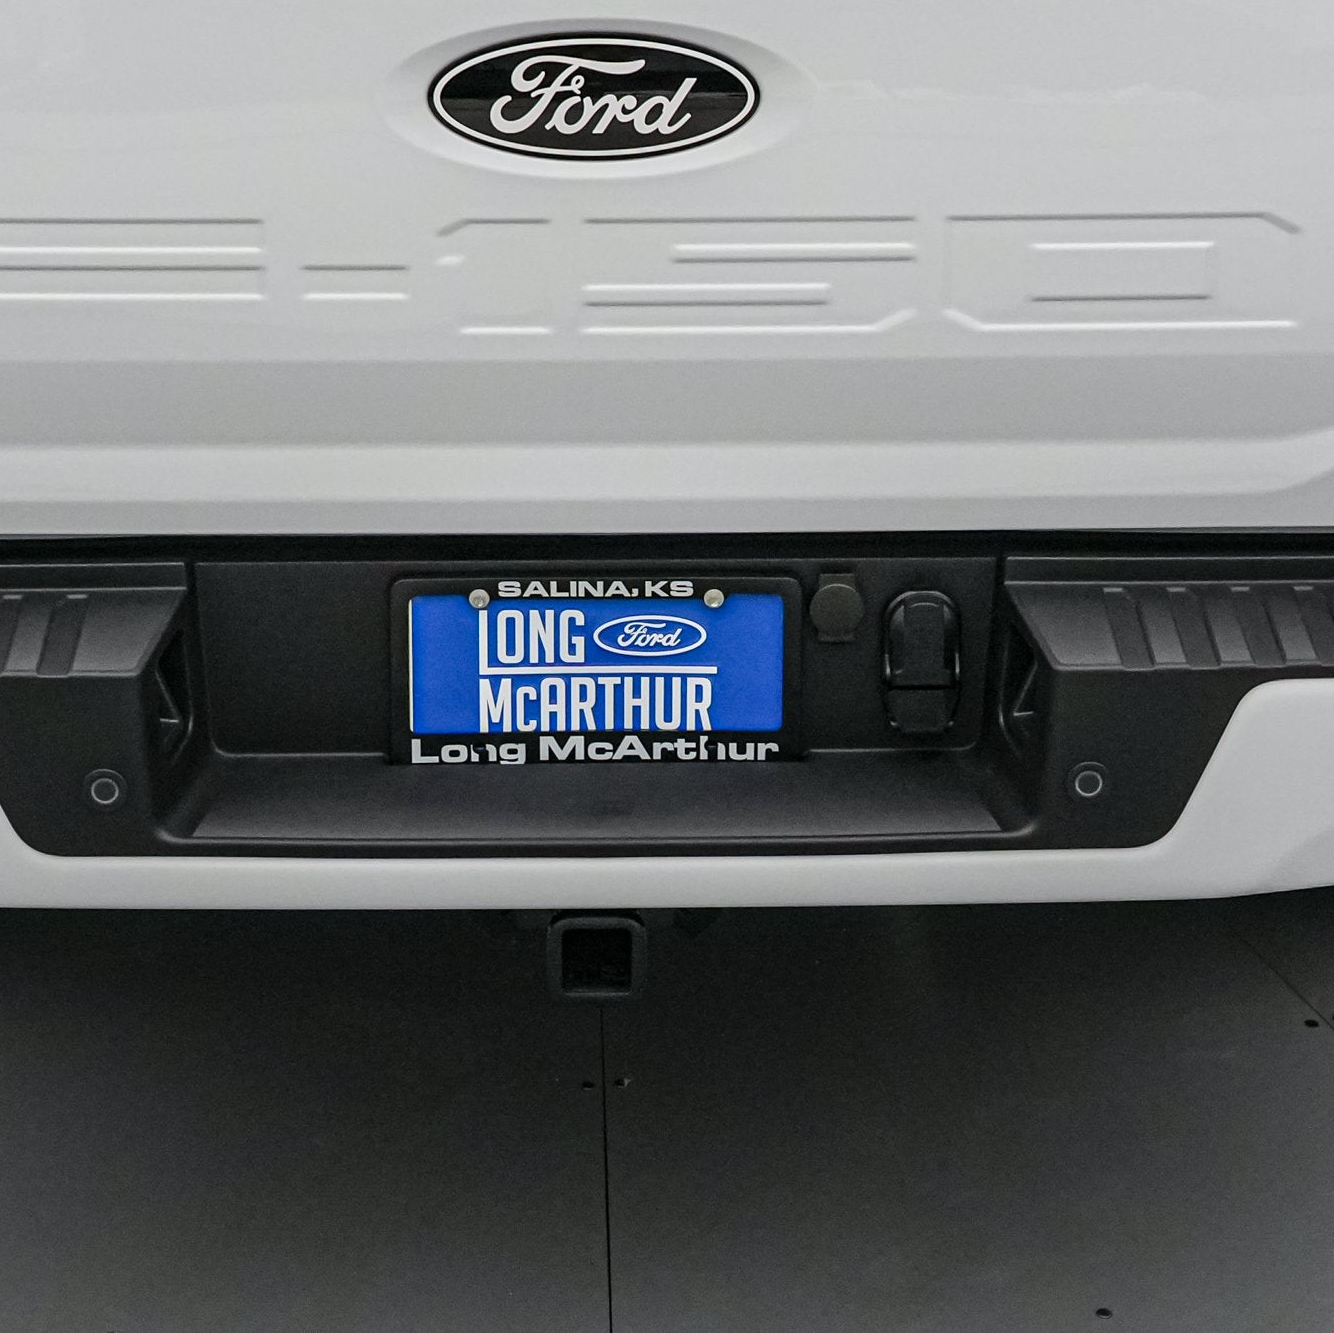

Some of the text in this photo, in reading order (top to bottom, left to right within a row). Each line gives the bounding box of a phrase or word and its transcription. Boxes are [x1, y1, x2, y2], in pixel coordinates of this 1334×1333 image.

[489, 54, 698, 135] Ford
[497, 580, 695, 598] SALINA, KS
[478, 609, 586, 675] LONG
[616, 621, 683, 648] Ford
[478, 676, 713, 733] McARTHUR
[410, 734, 780, 765] Long McArthur
